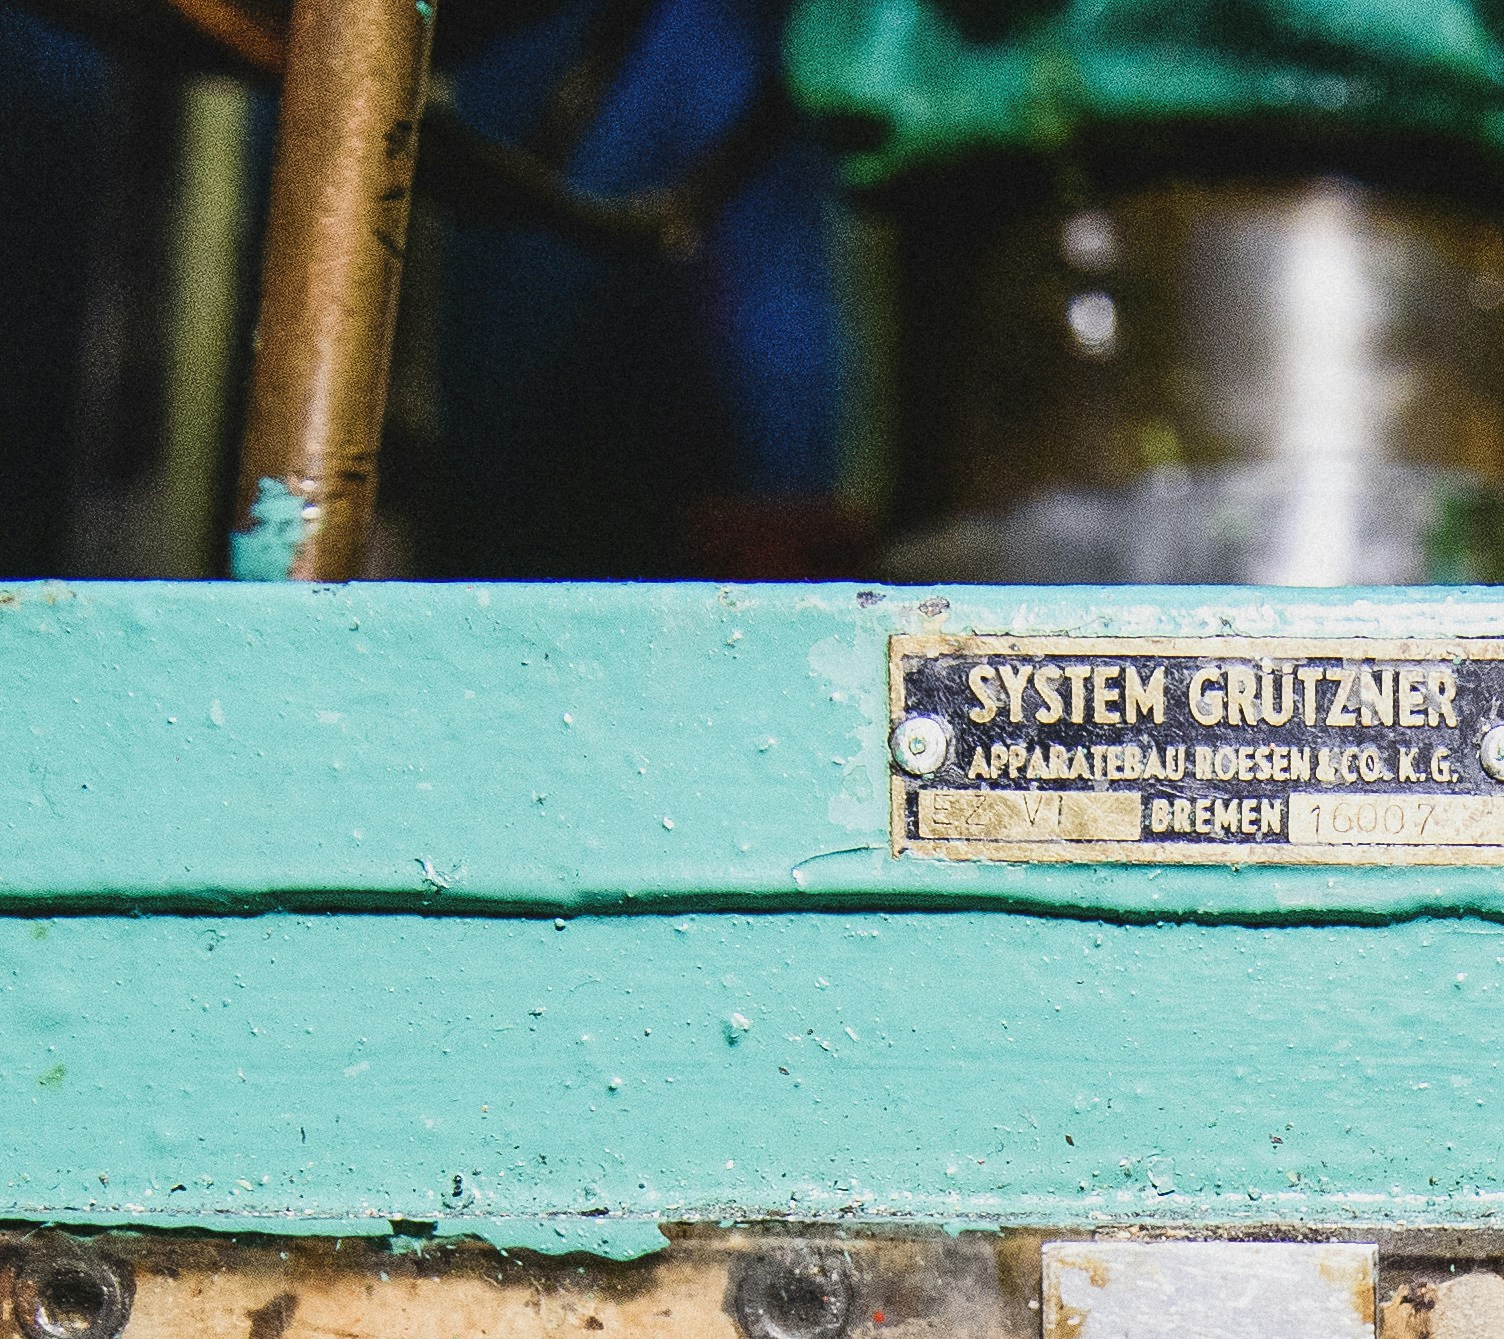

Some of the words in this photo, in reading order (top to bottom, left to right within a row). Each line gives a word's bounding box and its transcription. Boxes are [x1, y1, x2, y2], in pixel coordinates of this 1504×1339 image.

[966, 663, 1166, 726] SYSTEM
[1187, 661, 1458, 728] GRÜTZNER
[968, 745, 1186, 781] APPARATEBAU
[1194, 745, 1311, 782] ROESEN
[1151, 797, 1283, 835] BREMEN
[1310, 802, 1436, 836] 16007
